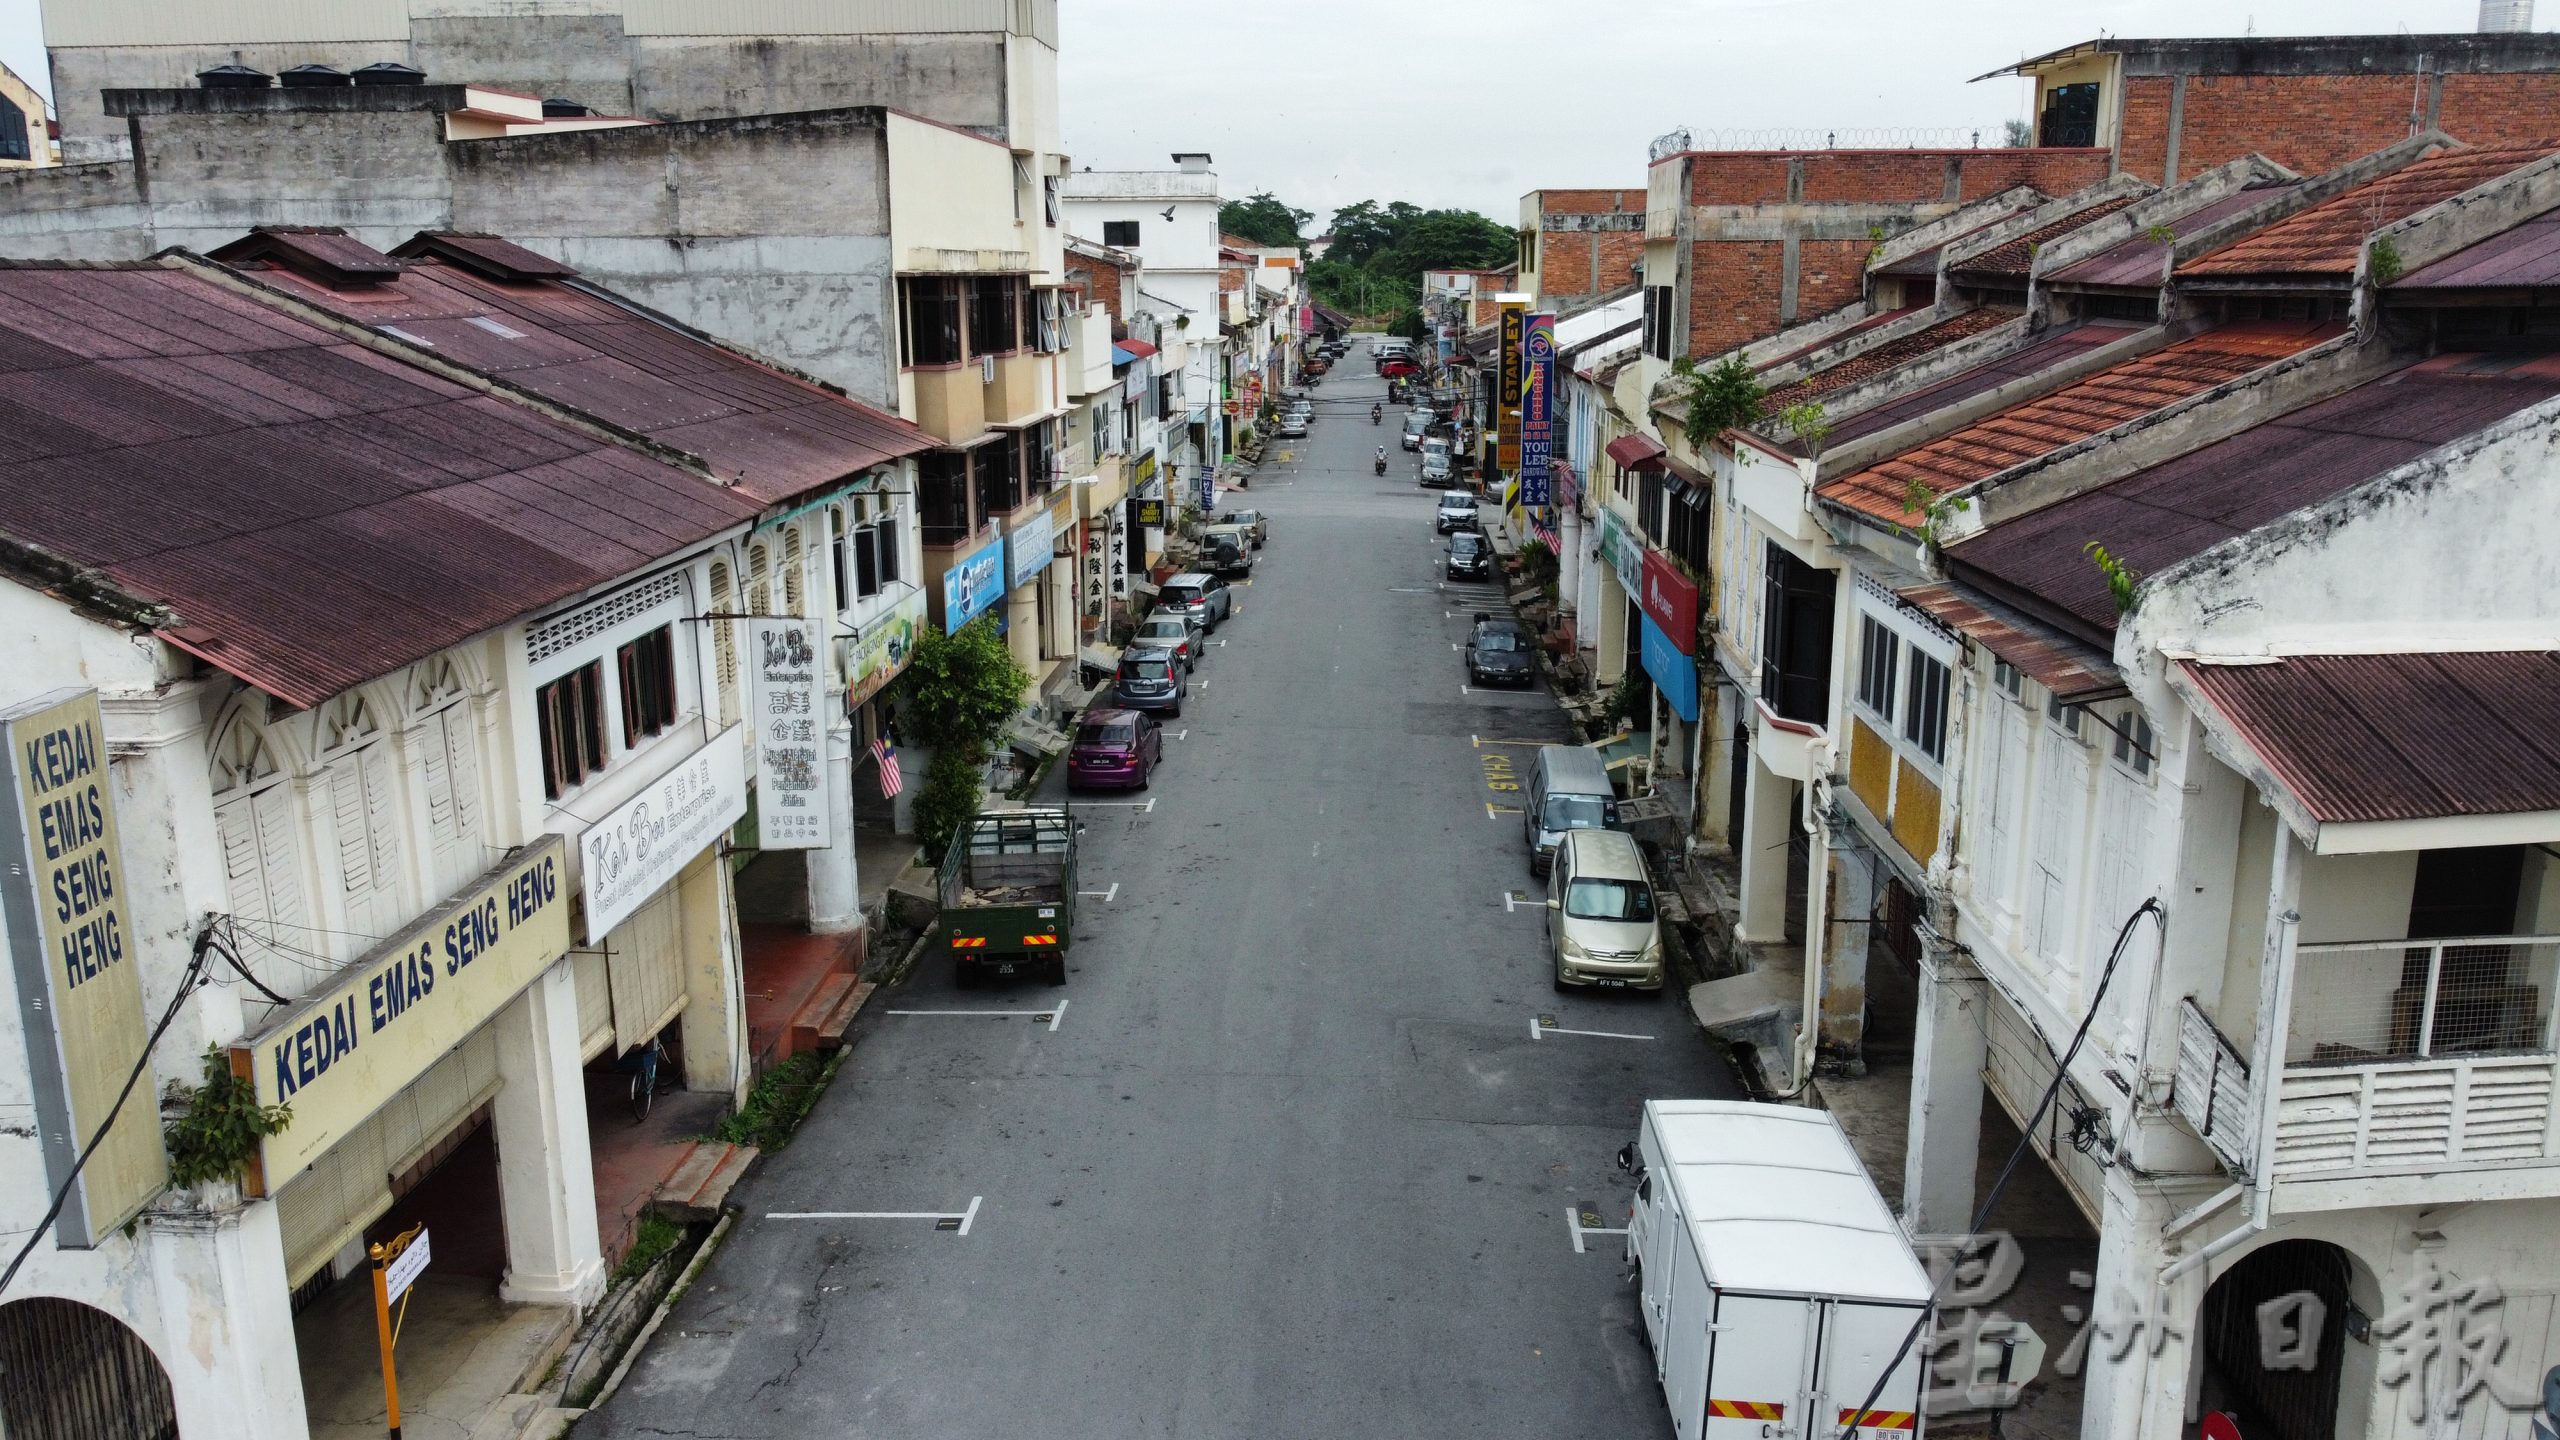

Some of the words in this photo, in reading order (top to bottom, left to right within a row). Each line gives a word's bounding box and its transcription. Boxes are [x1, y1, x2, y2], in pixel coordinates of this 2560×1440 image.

[1505, 315, 1519, 402] STANLEY
[1532, 363, 1545, 420] KANGAROO
[1524, 442, 1549, 453] YOU
[1525, 455, 1548, 465] LEE
[761, 630, 787, 670] Koh
[764, 671, 813, 683] Enterprise
[768, 691, 811, 714] 高美
[770, 719, 813, 741] 企業
[26, 718, 96, 797] KEDAI
[1481, 754, 1520, 790] KHAS
[38, 784, 103, 862] EMAS
[590, 825, 630, 900] Koh
[667, 784, 717, 832] Enterprise
[53, 848, 113, 924] SENG
[61, 910, 122, 989] HENG
[275, 994, 357, 1104] KEDAI
[369, 941, 435, 1034] EMAS
[445, 896, 498, 977] SENG
[507, 855, 556, 931] HENG
